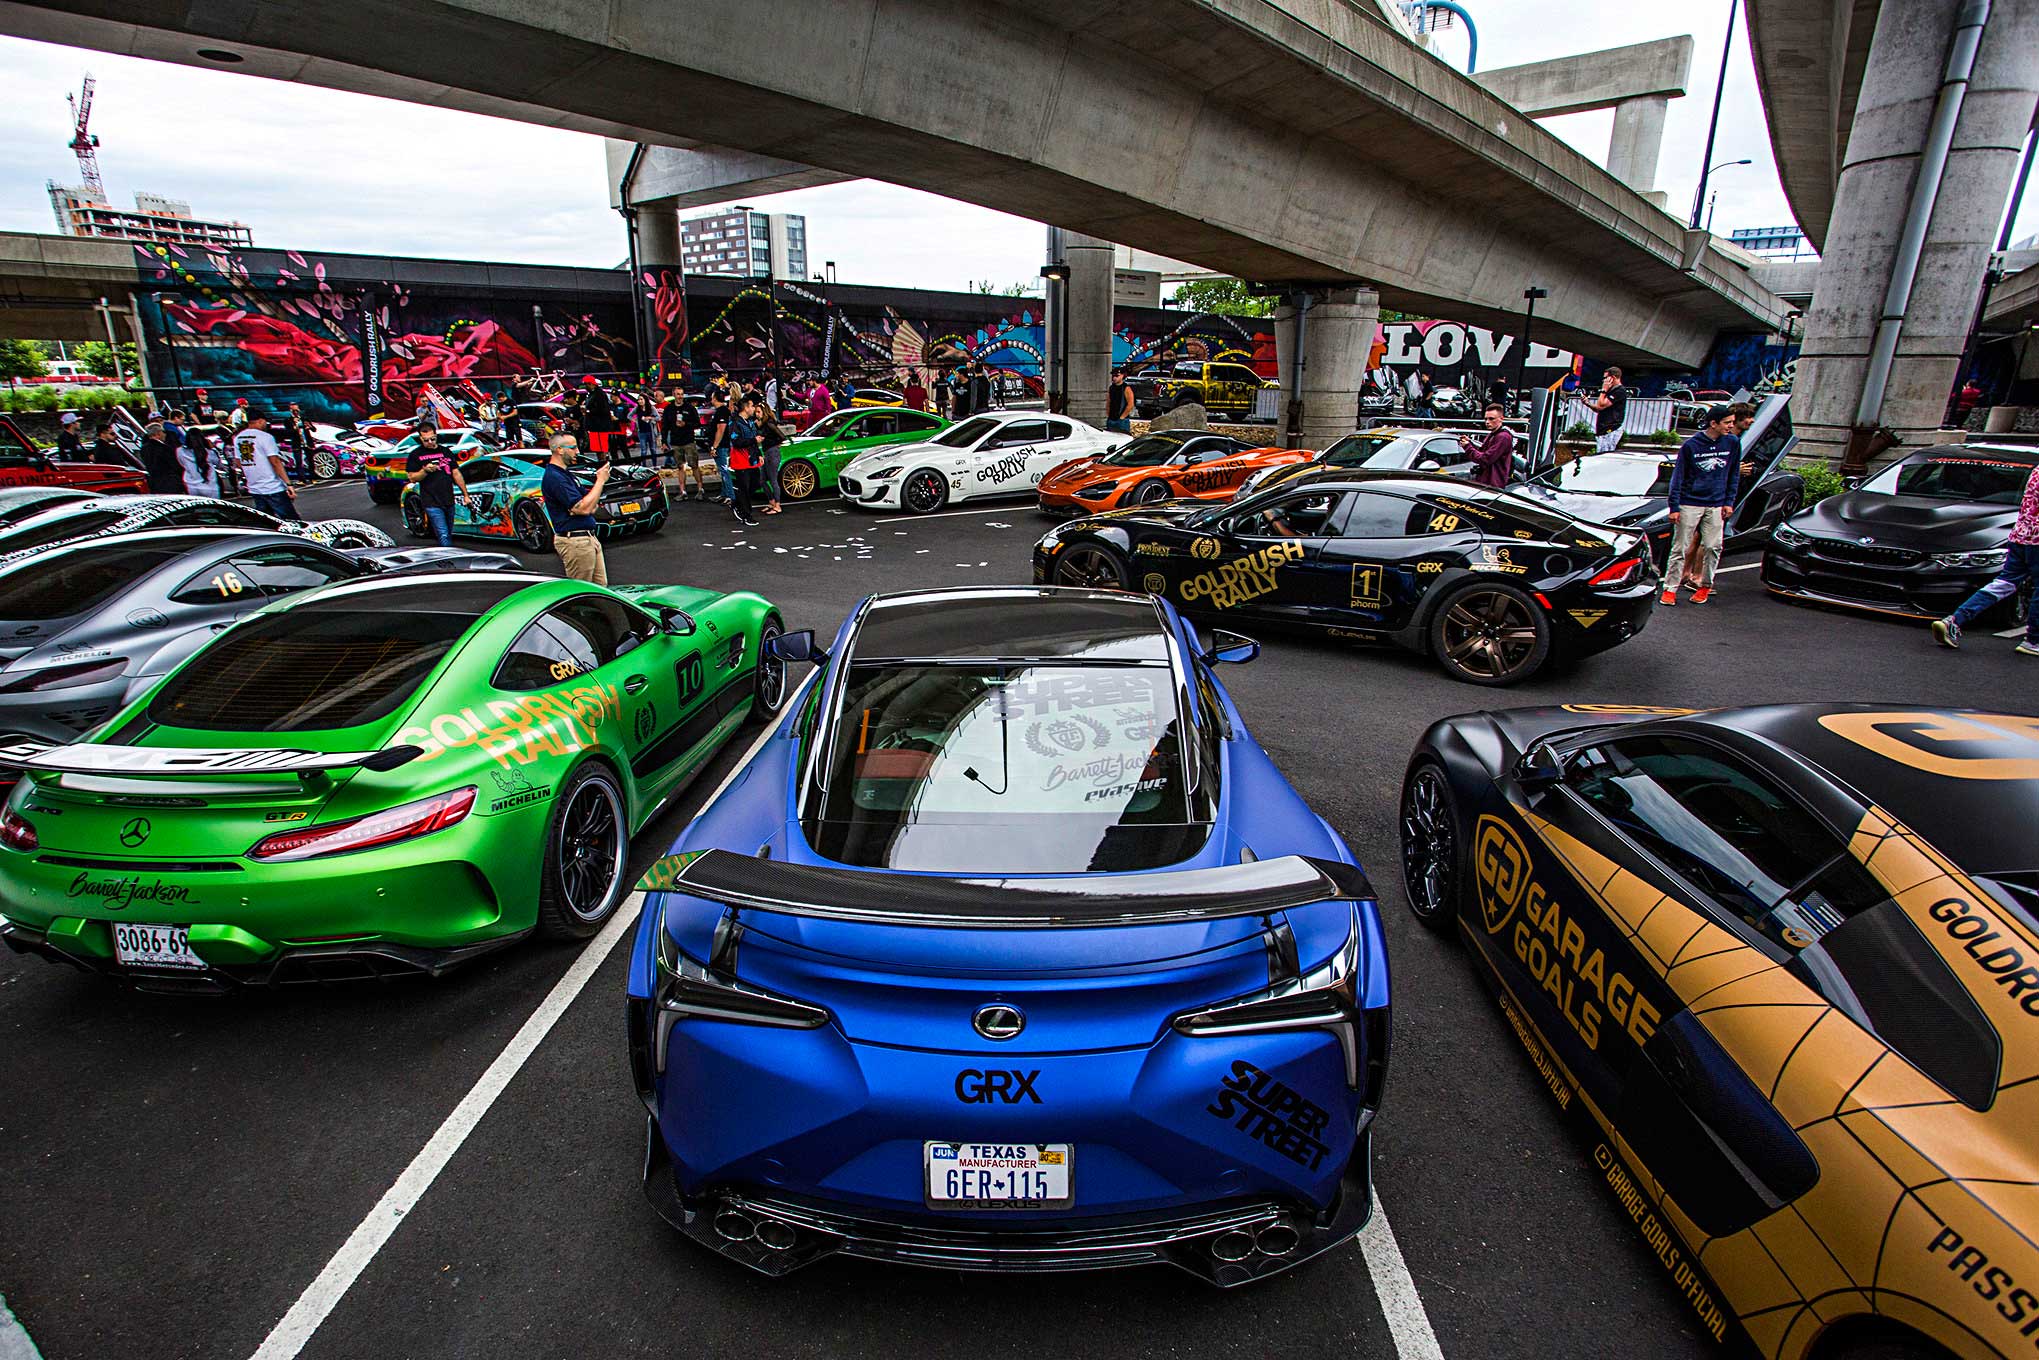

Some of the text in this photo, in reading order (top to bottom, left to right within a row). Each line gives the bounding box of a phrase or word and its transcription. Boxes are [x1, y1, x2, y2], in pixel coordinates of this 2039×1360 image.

[364, 310, 379, 392] GOLDRUSH RALLY
[976, 445, 1036, 482] GOLDRUSH
[993, 460, 1026, 486] RALLY
[1183, 460, 1247, 486] GOLDRUSH
[950, 479, 961, 489] 45
[1196, 470, 1233, 492] RALLY
[1429, 513, 1460, 533] 49
[1180, 538, 1305, 601] GOLDRUSH
[1416, 562, 1444, 573] GRX
[1469, 564, 1527, 574] MICHELIN
[212, 571, 243, 597] 16
[1210, 568, 1278, 609] RALLY
[1350, 599, 1380, 610] phorm
[550, 658, 582, 680] GRX
[679, 658, 702, 699] 10
[392, 684, 622, 763] GOLDRUSH
[478, 714, 600, 771] RALLY
[491, 787, 551, 813] MICHELIN
[1084, 777, 1168, 802] evasive
[1525, 882, 1662, 1047] GARAGE
[1514, 921, 1602, 1050] GOALS
[954, 1068, 1044, 1104] GRX
[1220, 1060, 1330, 1139] SUPER
[1206, 1088, 1331, 1172] STREET
[935, 1148, 955, 1157] JUN
[959, 1158, 1037, 1169] MANUFACTURER
[971, 1146, 1026, 1159] TEXAS
[977, 1200, 1041, 1209] LEXUS
[1606, 1163, 1727, 1344] GARAGE GOALS OFFICIAL
